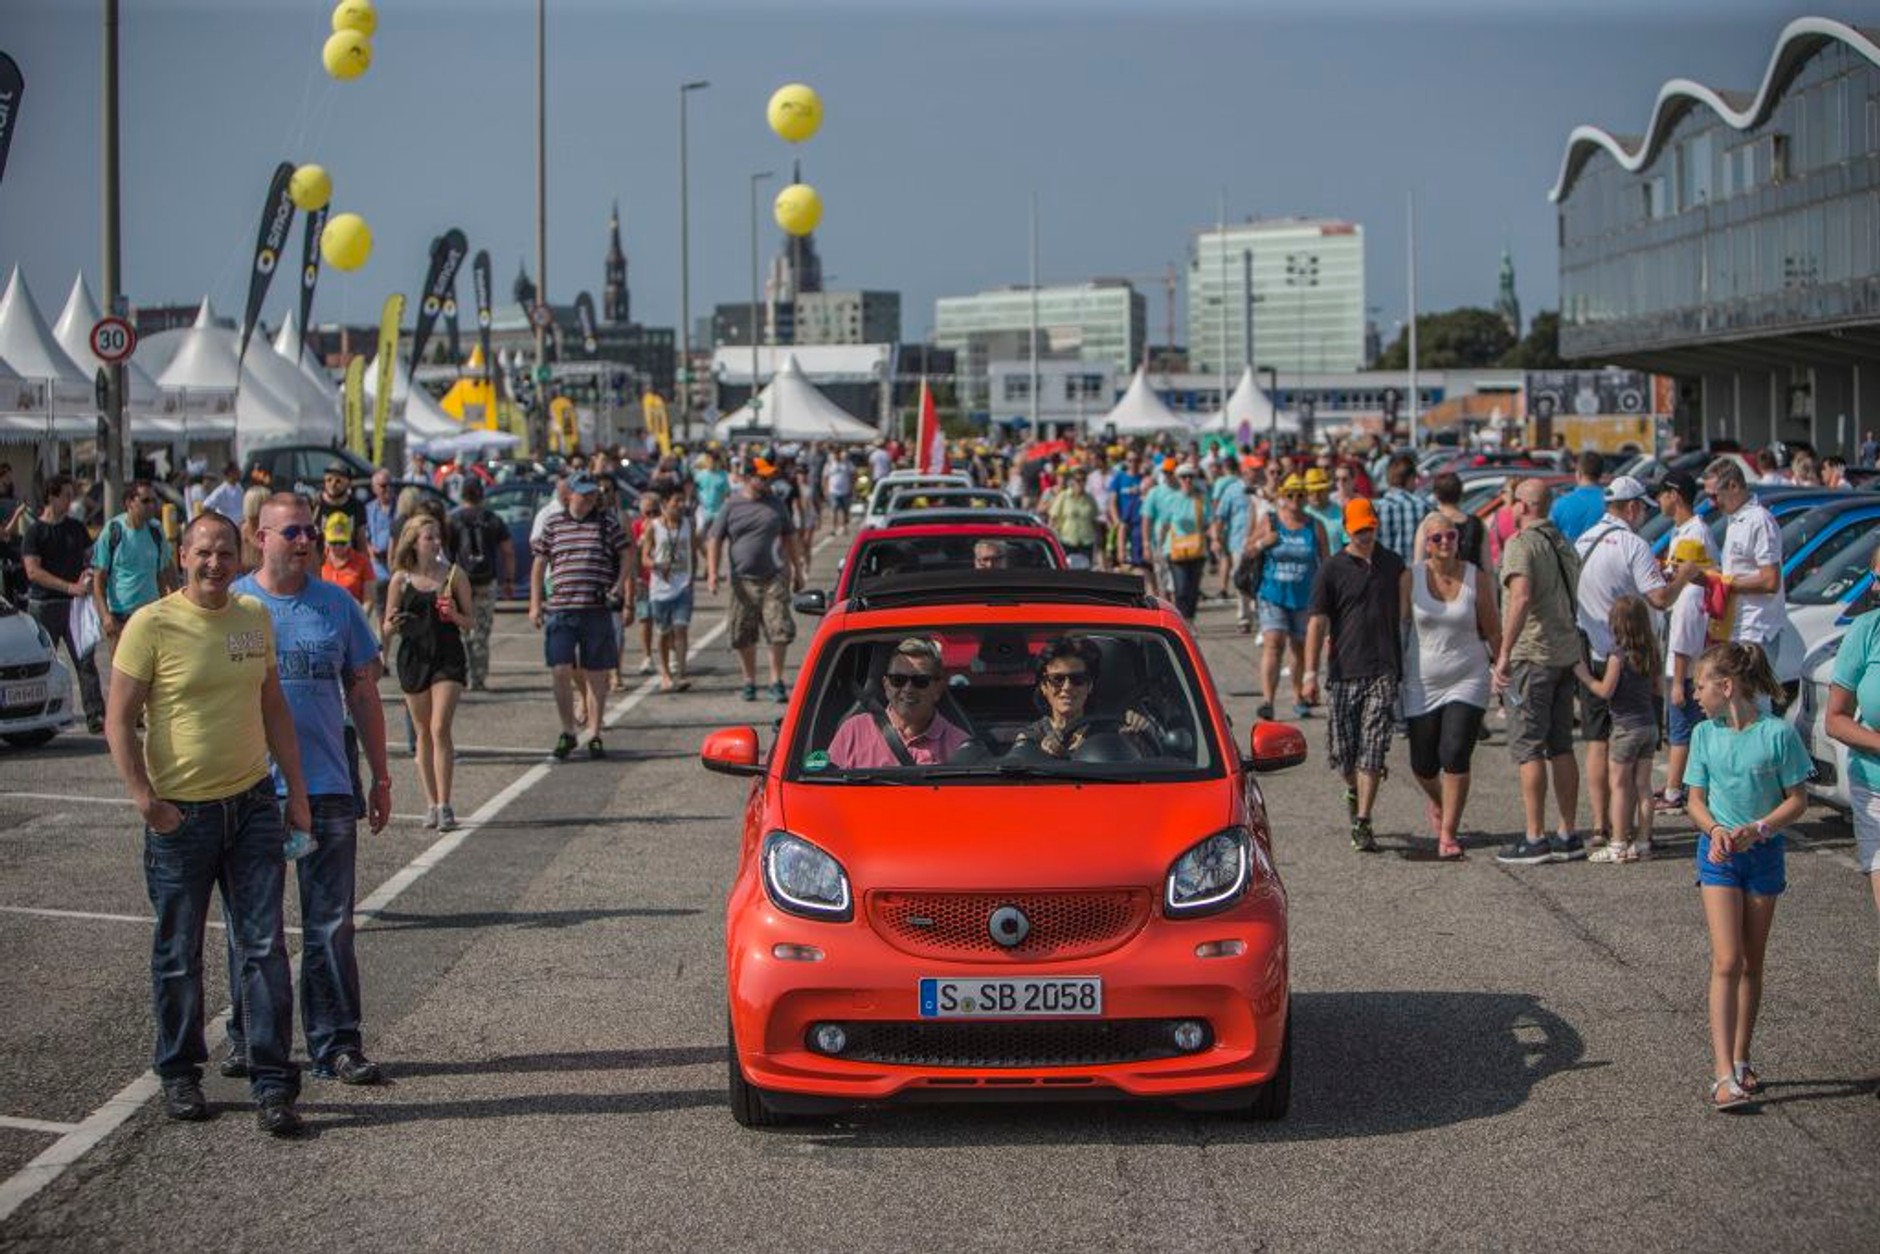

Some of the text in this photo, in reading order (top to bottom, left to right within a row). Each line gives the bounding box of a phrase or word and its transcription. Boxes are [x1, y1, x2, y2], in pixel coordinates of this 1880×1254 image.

[99, 329, 125, 351] 30
[940, 983, 1096, 1011] S SB 2058
